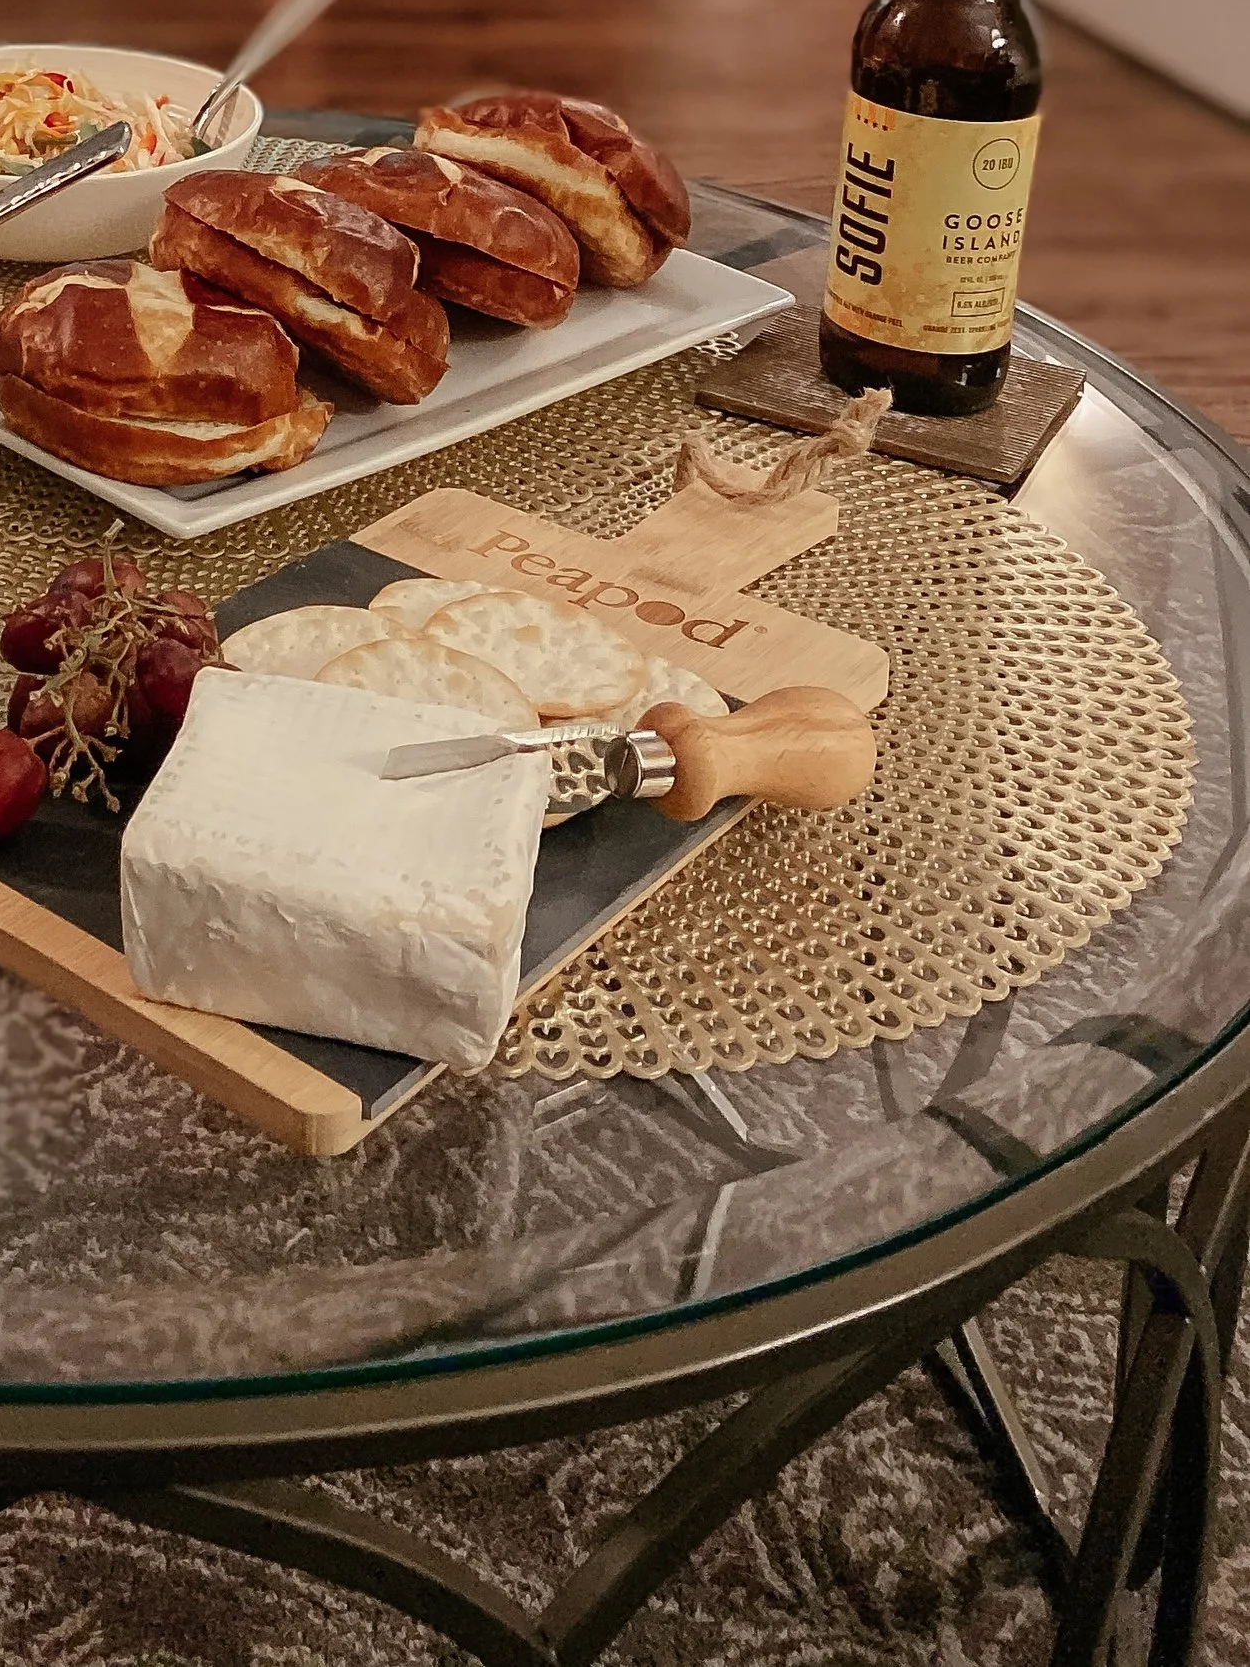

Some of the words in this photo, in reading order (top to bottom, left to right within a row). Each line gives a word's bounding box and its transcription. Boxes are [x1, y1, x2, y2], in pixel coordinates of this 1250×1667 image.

[982, 158, 996, 171] 20
[998, 157, 1013, 170] IBU
[836, 142, 895, 286] SOFIE
[944, 208, 1024, 230] GOOSE
[942, 230, 1020, 251] ISLAND
[946, 256, 973, 265] BEER
[467, 529, 750, 650] Peapod
